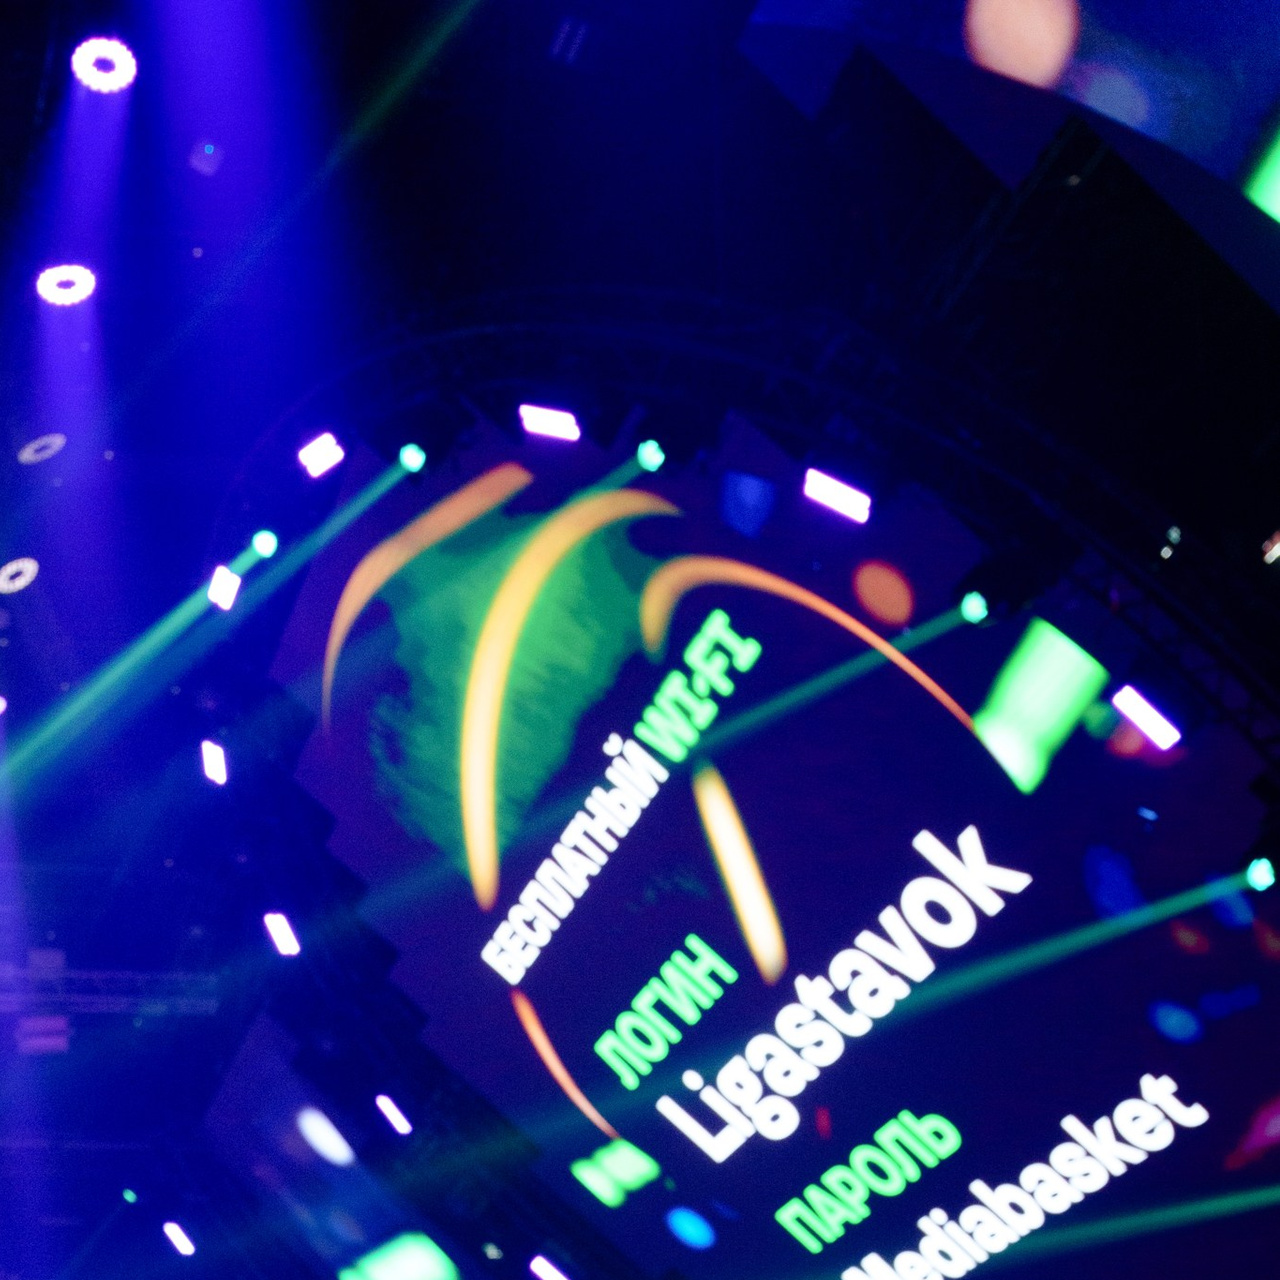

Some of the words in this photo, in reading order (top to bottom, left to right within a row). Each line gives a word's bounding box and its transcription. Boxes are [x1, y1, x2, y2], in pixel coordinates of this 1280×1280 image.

[480, 732, 670, 986] БЕСПЛАТНЫЙ
[634, 608, 763, 764] WI-FI
[593, 933, 739, 1090] ЛОГИН
[656, 824, 1033, 1163] Ligastavok
[774, 1109, 963, 1255] ПАРОЛЬ
